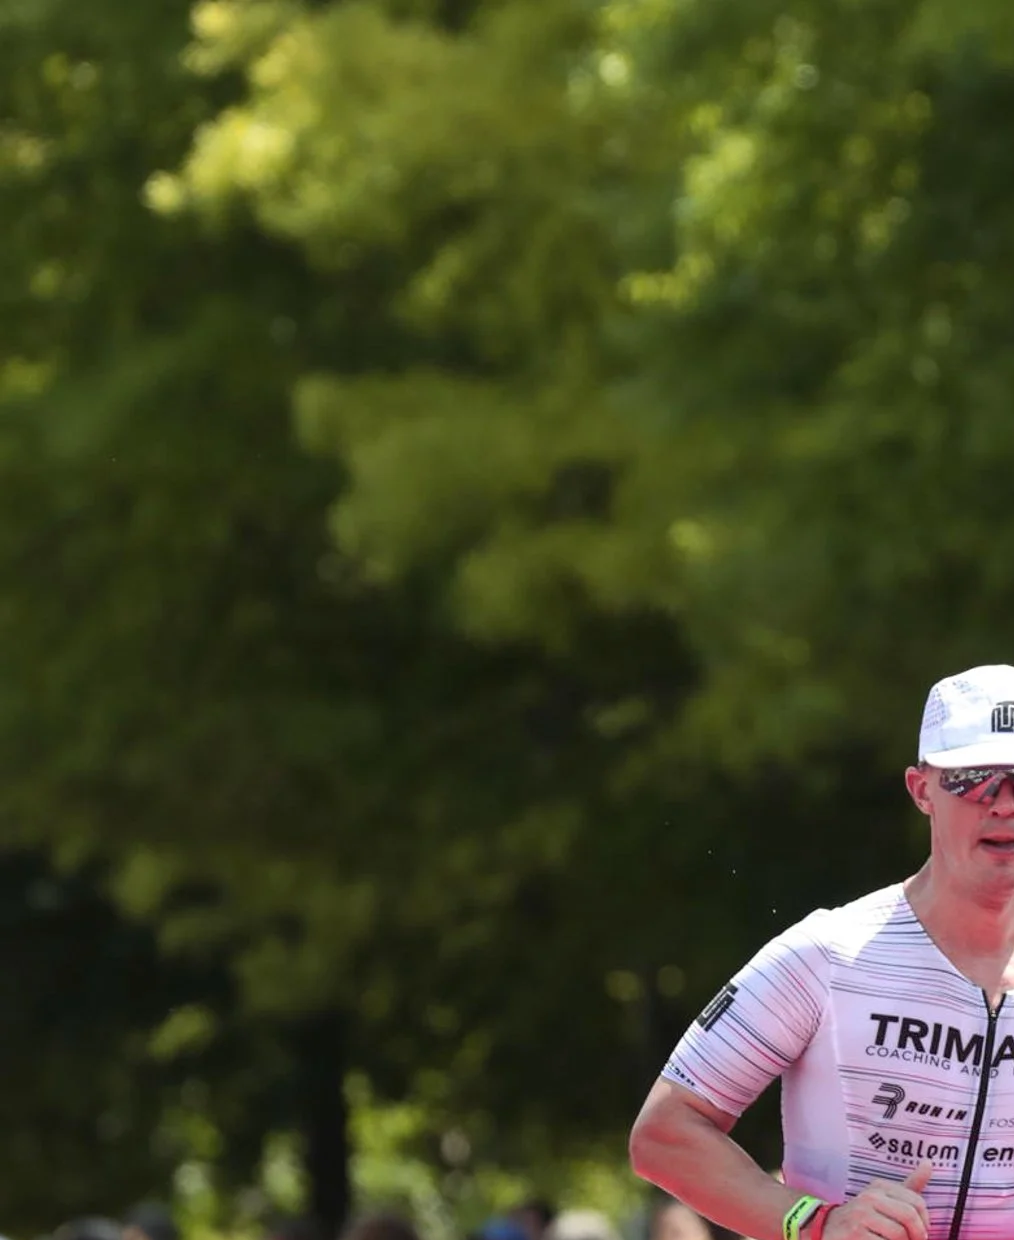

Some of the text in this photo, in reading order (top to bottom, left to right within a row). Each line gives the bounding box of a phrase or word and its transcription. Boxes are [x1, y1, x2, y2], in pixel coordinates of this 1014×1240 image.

[865, 1046, 951, 1070] COACHING
[960, 1064, 999, 1079] AND
[904, 1101, 968, 1121] RUN IN
[887, 1138, 960, 1160] salem
